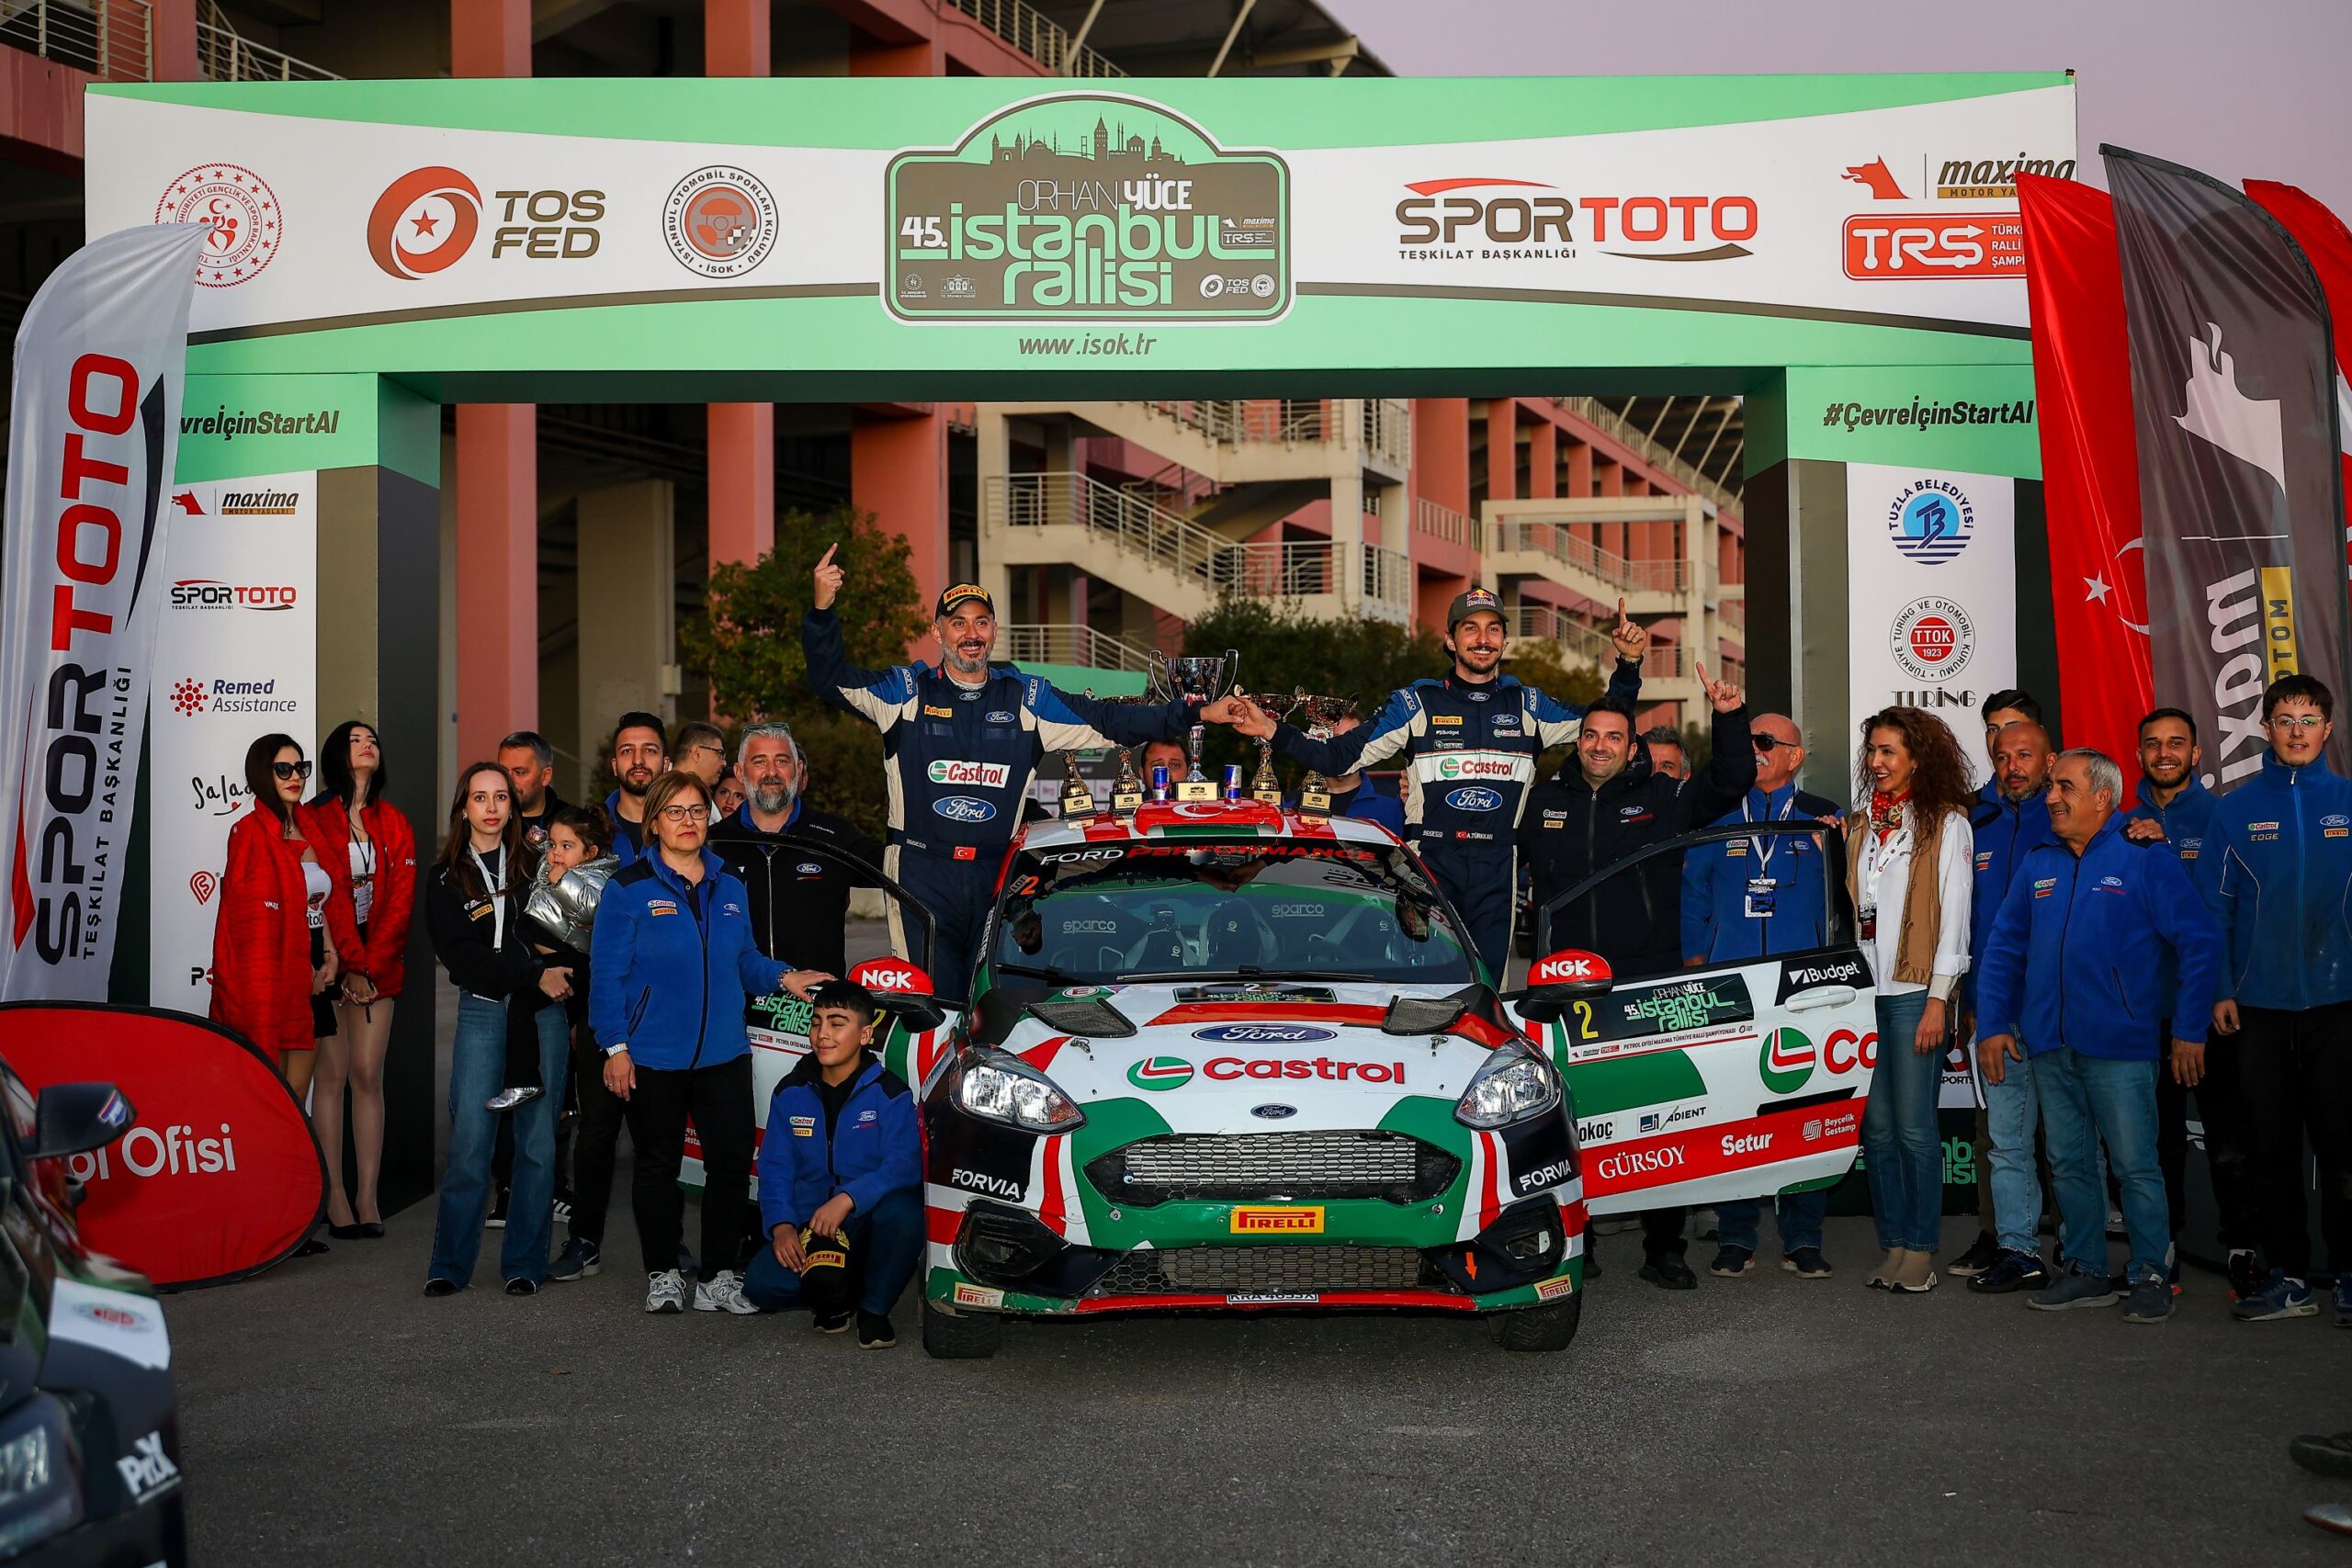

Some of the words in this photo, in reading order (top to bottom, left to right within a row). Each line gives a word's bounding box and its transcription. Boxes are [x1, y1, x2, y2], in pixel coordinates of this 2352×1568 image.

[673, 170, 725, 205] OTOMOBİL
[729, 173, 773, 216] SPORLARI
[1018, 179, 1118, 210] ORHAN
[1123, 173, 1193, 209] YÜCE
[1950, 188, 1995, 197] MOTOR
[248, 204, 259, 226] SPOR
[494, 189, 605, 222] TOS
[950, 202, 1275, 260] istanbul
[1396, 197, 1574, 244] SPOR
[1579, 197, 1758, 242] TOTO
[492, 227, 600, 259] FED
[669, 209, 695, 264] İSTANBUL
[1851, 224, 1984, 269] TRS
[1992, 239, 2021, 250] RALLİ
[1398, 248, 1475, 261] TEŞKİLAT
[1481, 247, 1577, 261] BAŞKANLIĞI
[707, 264, 734, 273] İSOK
[1002, 239, 1172, 306] rallisi
[1226, 278, 1250, 287] TOS
[1018, 333, 1157, 355] www.isok.tr
[51, 353, 140, 651] TOTO
[222, 489, 300, 507] maxima
[1889, 488, 1914, 530] TUZLA
[1915, 479, 1973, 529] BELEDİYESİ
[171, 586, 232, 604] SPOR
[234, 586, 297, 604] TOTO
[1917, 600, 1930, 610] VE
[1894, 608, 1916, 641] TURİNG
[1935, 601, 1973, 639] OTOMOBİL
[1914, 630, 1951, 644] TTOK
[1894, 646, 1928, 678] TÜRKİYE
[1922, 648, 1942, 658] 1923
[1939, 643, 1972, 678] KURUMU
[212, 678, 276, 695] Remed
[1027, 679, 1038, 706] sparco
[1891, 687, 1976, 707] TURİNG
[211, 696, 297, 713] Assistance
[925, 706, 951, 716] PIRELLI
[989, 712, 1009, 721] Ford
[1496, 715, 1515, 725] Ford
[948, 762, 1003, 784] Castrol
[1461, 760, 1513, 776] Castrol
[945, 798, 986, 818] Ford
[1456, 787, 1493, 809] Ford
[35, 662, 107, 965] SPOR
[83, 836, 109, 960] TEŞKİLAT
[99, 667, 132, 824] BAŞKANLIĞI
[2325, 816, 2345, 825] Ford
[2251, 833, 2279, 841] EDGE
[1040, 850, 1125, 866] FORD
[1125, 845, 1377, 862] PERFORMANCE
[1020, 875, 1039, 896] 2
[1272, 904, 1325, 917] sparco
[1062, 920, 1116, 933] sparco
[861, 969, 914, 988] NGK
[1541, 958, 1592, 979] NGK
[1807, 961, 1860, 982] Budget
[1244, 983, 1262, 992] 2
[1653, 987, 1685, 1000] ORHAN
[1682, 982, 1706, 995] YÜCE
[1636, 991, 1736, 1019] istanbul
[1573, 1000, 1599, 1040] 2
[1658, 1006, 1709, 1032] rallisi
[1229, 1025, 1306, 1042] Ford
[1623, 1042, 1641, 1050] PETROL
[1653, 1037, 1672, 1045] MAXIMA
[1672, 1034, 1692, 1043] TÜRKİYE
[1203, 1056, 1406, 1085] Castrol
[1261, 1105, 1288, 1117] Ford
[1665, 1106, 1707, 1122] ADIENT
[1825, 1113, 1854, 1127] Beyçelik
[1825, 1122, 1856, 1136] Gestamp
[121, 1122, 236, 1177] Ofisi
[1721, 1131, 1773, 1156] Setur
[1598, 1145, 1686, 1179] GÜRSOY
[951, 1168, 1021, 1199] FORVIA
[1519, 1158, 1572, 1191] FORVIA
[1238, 1211, 1317, 1228] PIRELLI
[1538, 1277, 1570, 1298] PIRELLI
